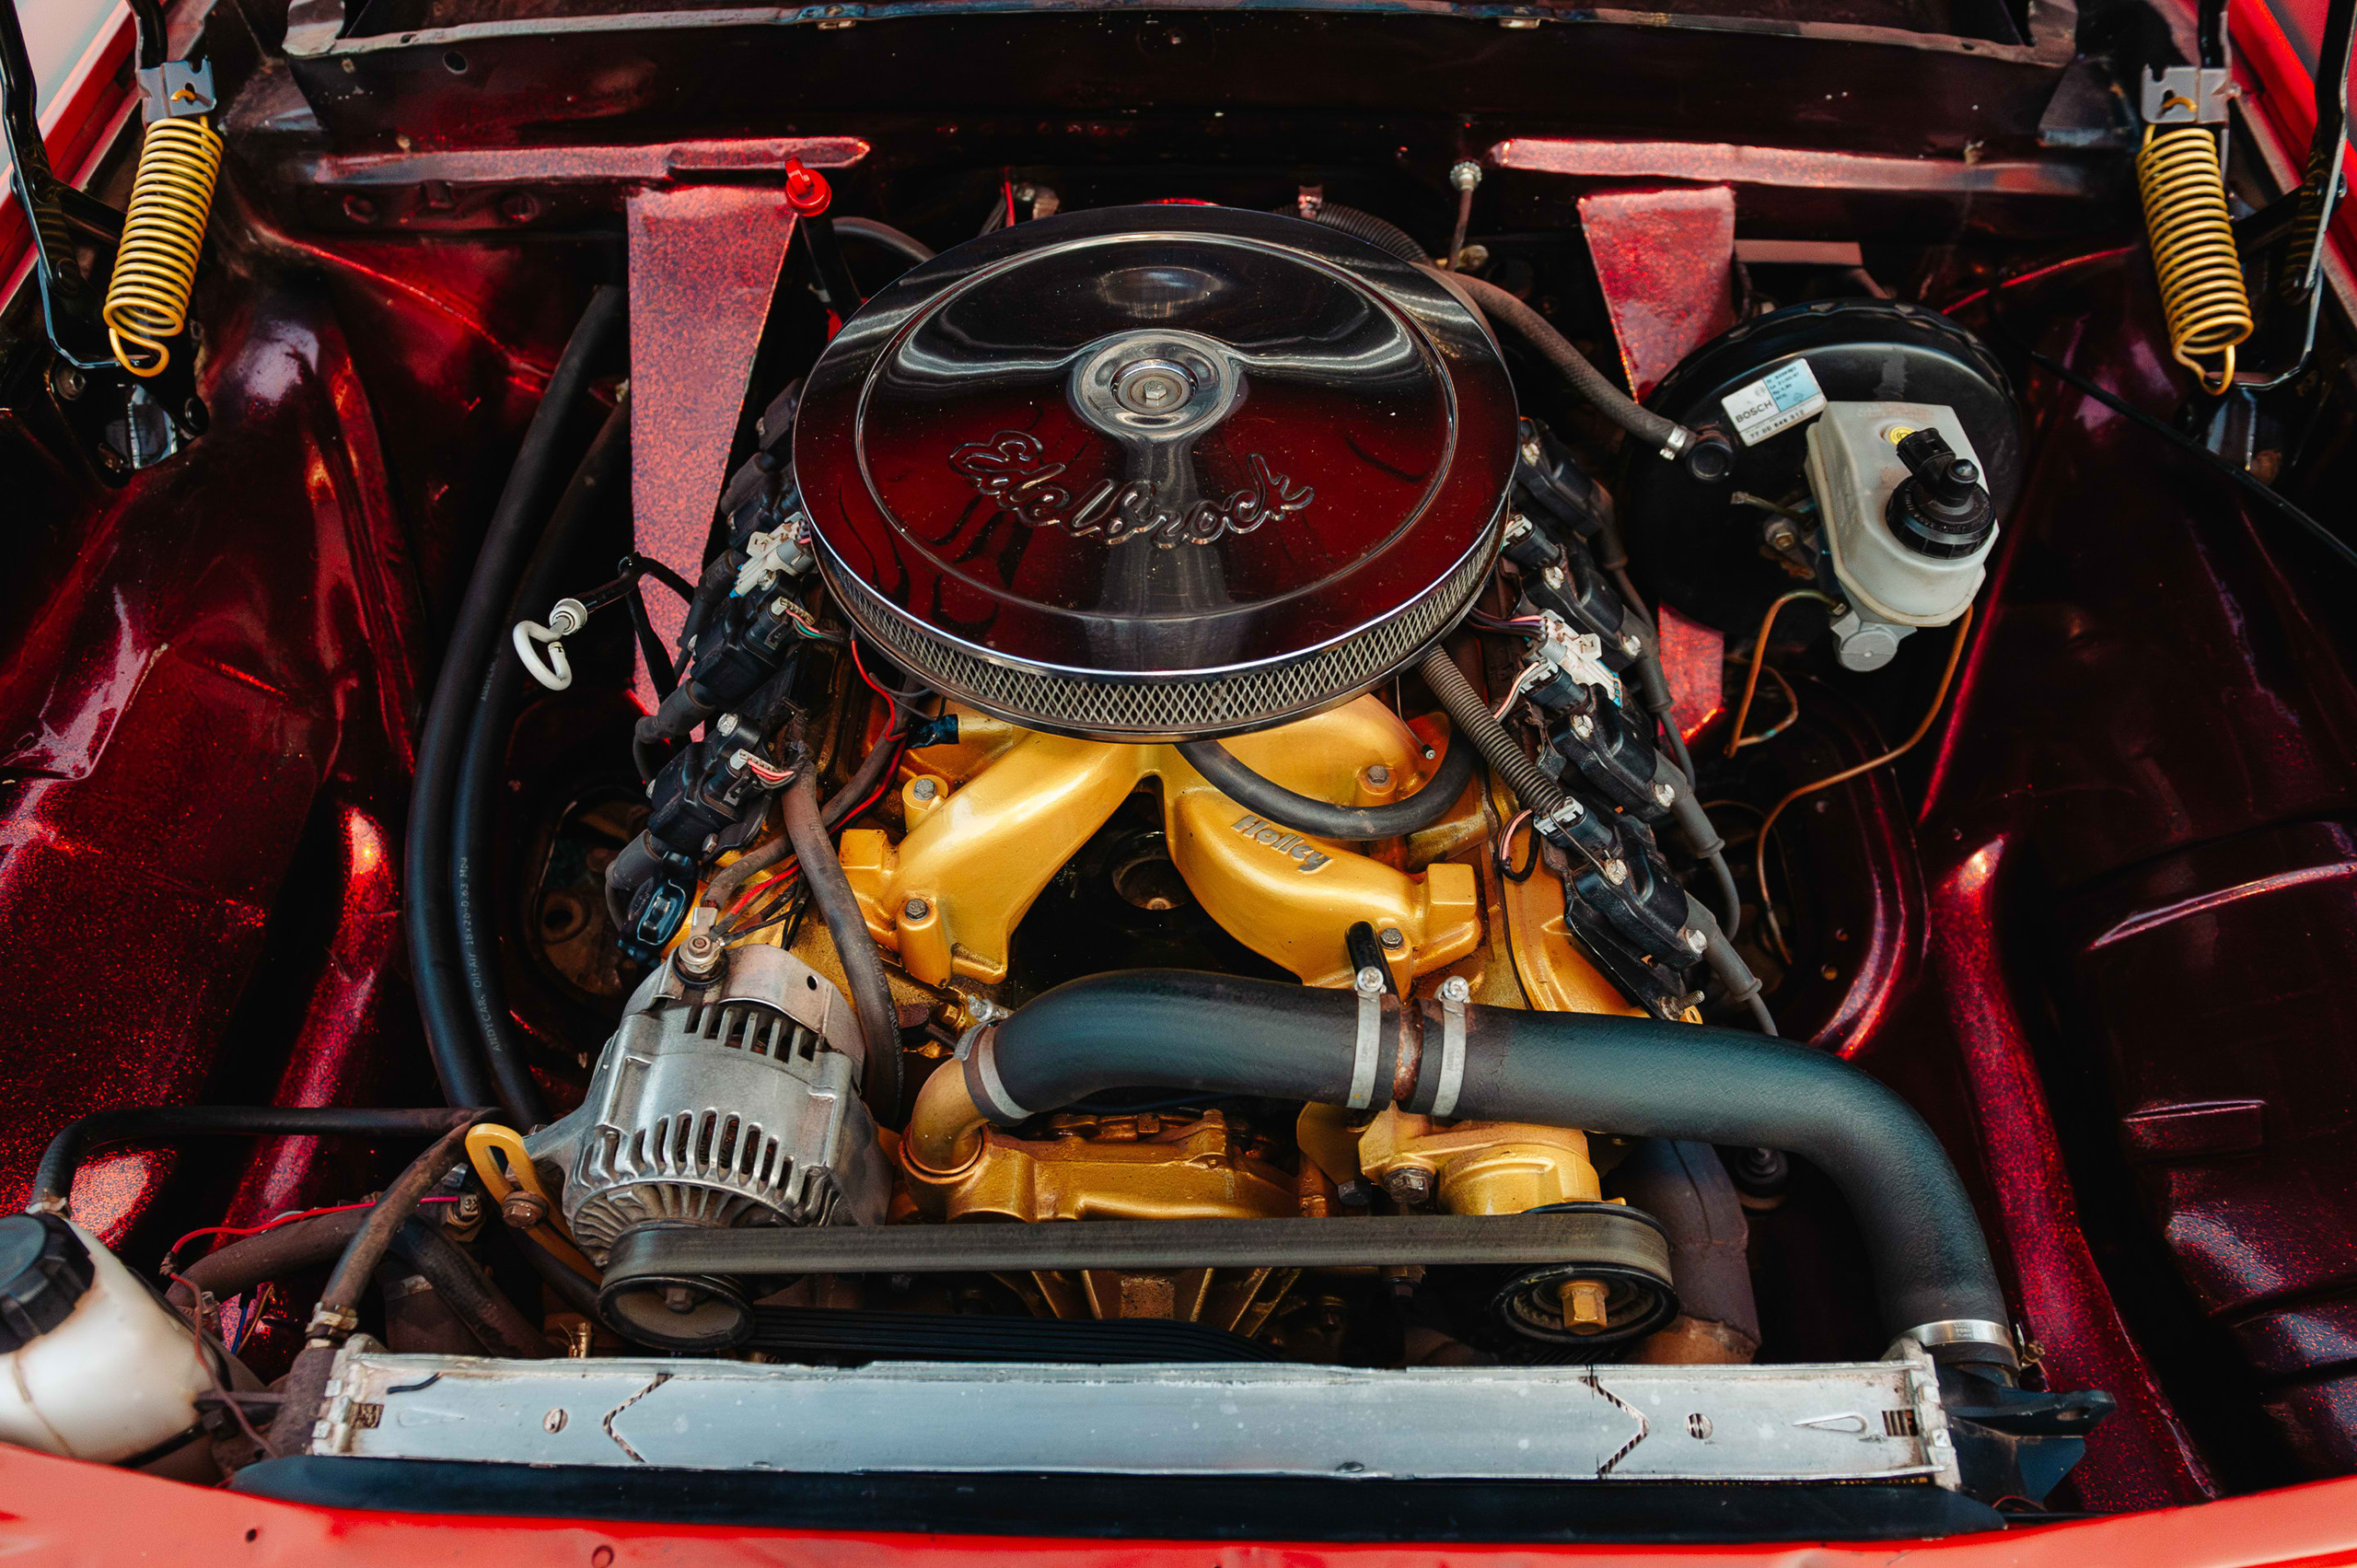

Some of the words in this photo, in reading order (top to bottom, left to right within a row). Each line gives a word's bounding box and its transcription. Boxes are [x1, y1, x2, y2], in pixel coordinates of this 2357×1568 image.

[1736, 400, 1773, 424] BOSCH
[948, 430, 1315, 550] Edelbrock
[1231, 815, 1333, 875] Holley
